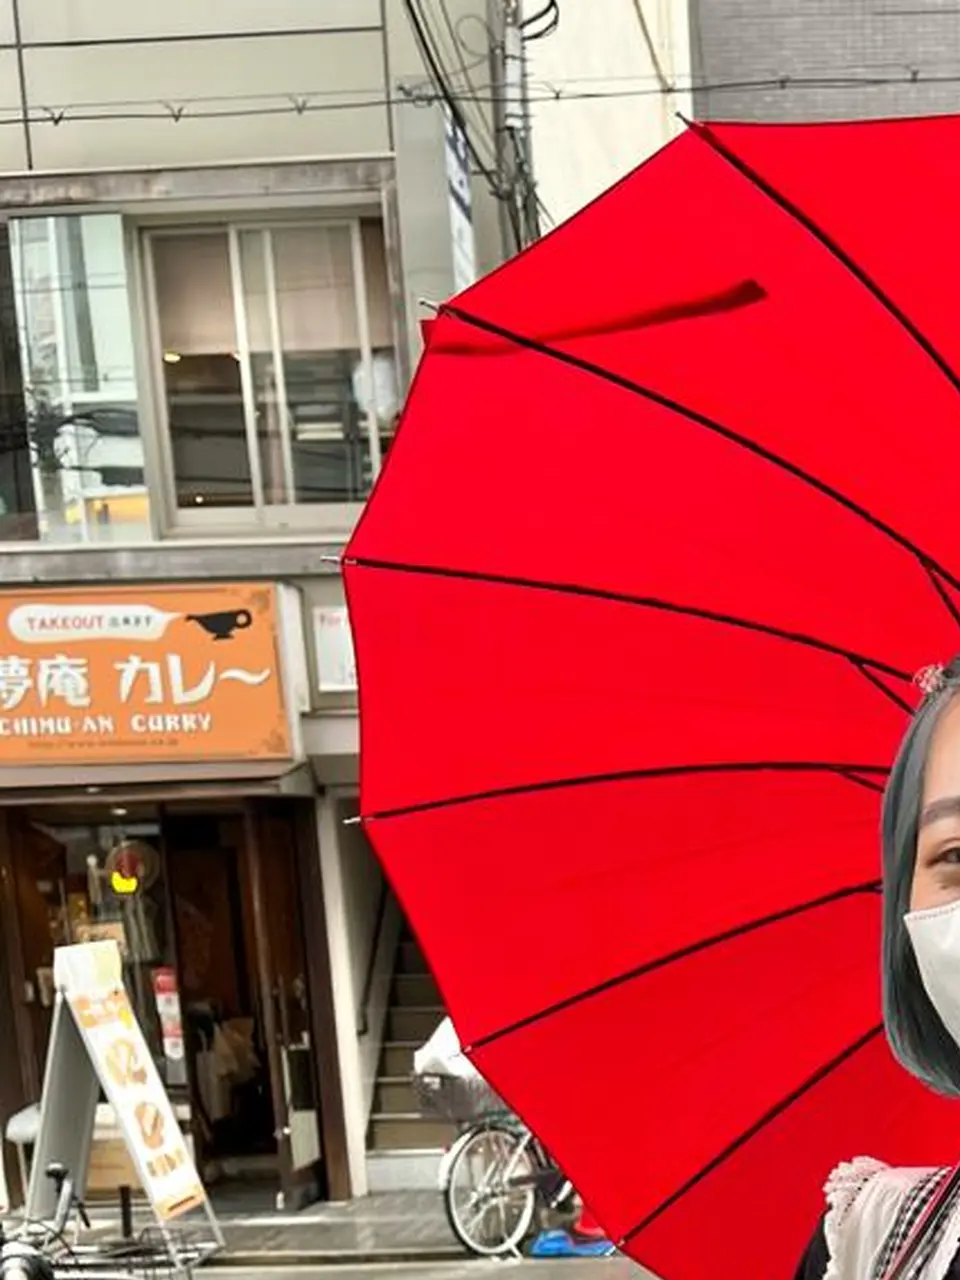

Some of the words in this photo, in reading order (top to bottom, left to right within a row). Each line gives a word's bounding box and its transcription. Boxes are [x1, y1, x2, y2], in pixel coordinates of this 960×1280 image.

[27, 614, 104, 631] TAKEOUT
[82, 716, 114, 733] AN
[131, 713, 211, 733] CURRY
